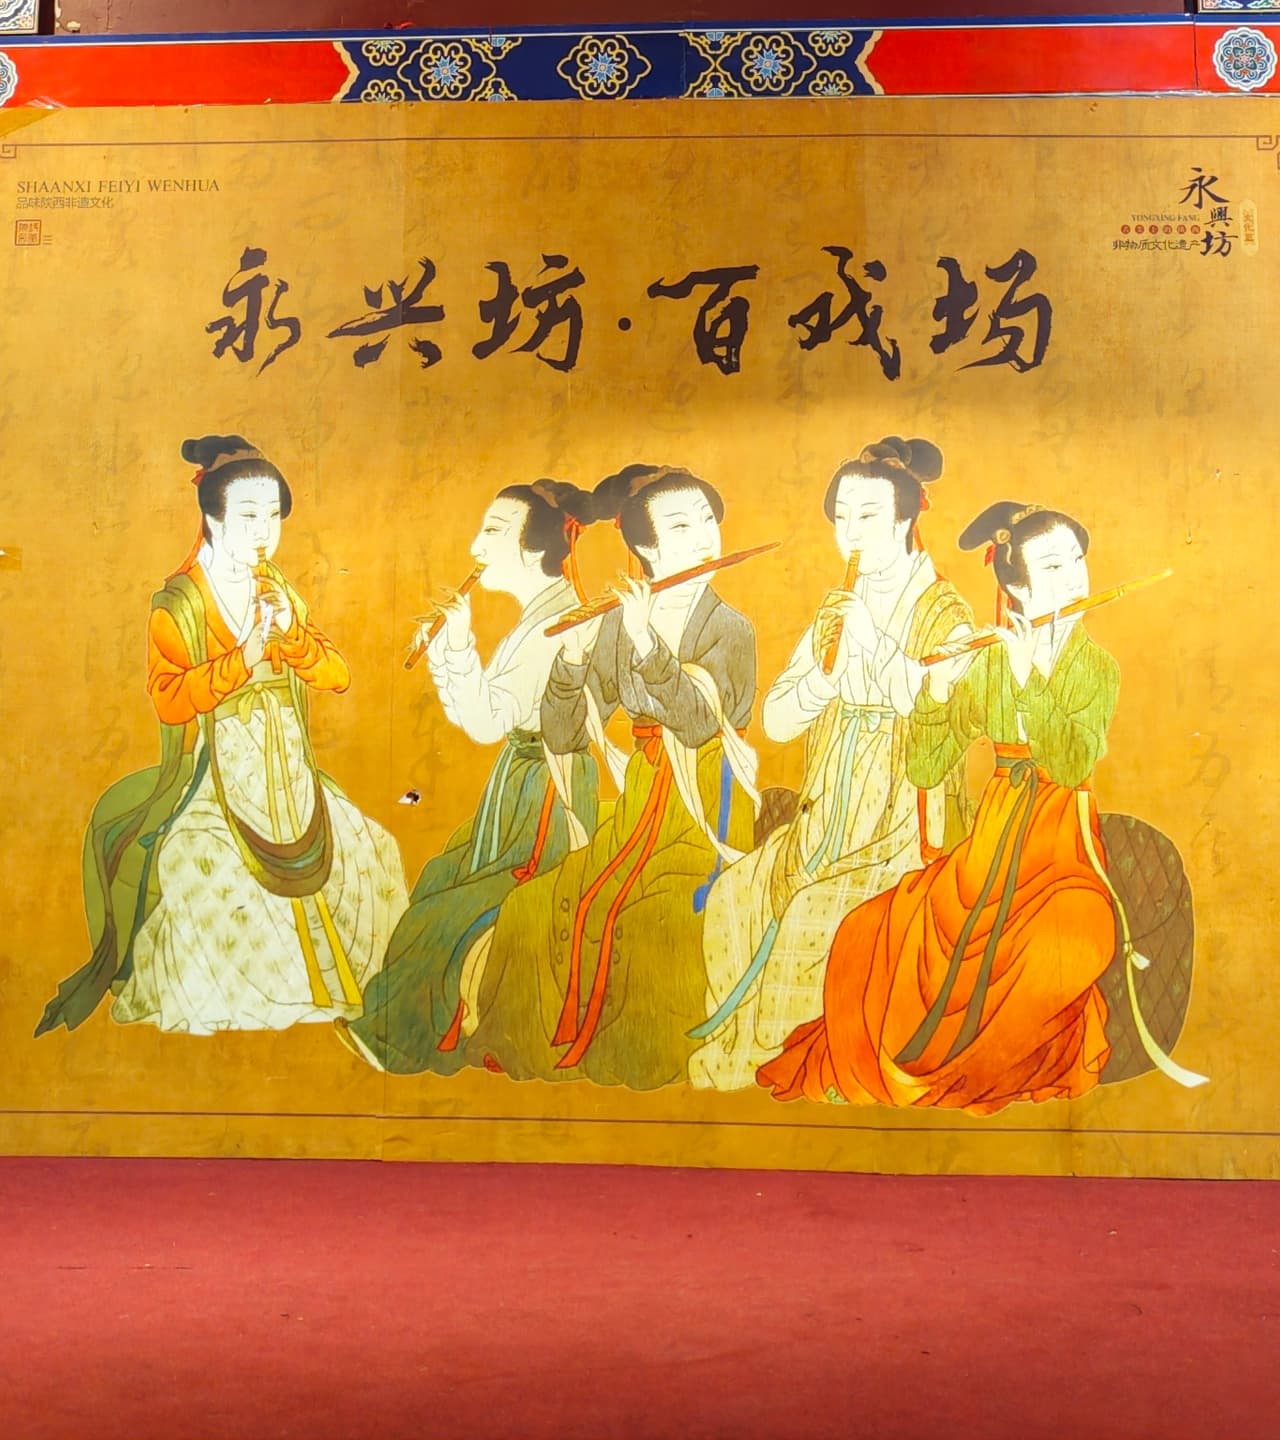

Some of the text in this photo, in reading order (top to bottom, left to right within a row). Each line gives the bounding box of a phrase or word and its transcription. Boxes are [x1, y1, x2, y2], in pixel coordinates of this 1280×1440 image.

[17, 179, 220, 194] SHAANXI FEIYI WENHUA
